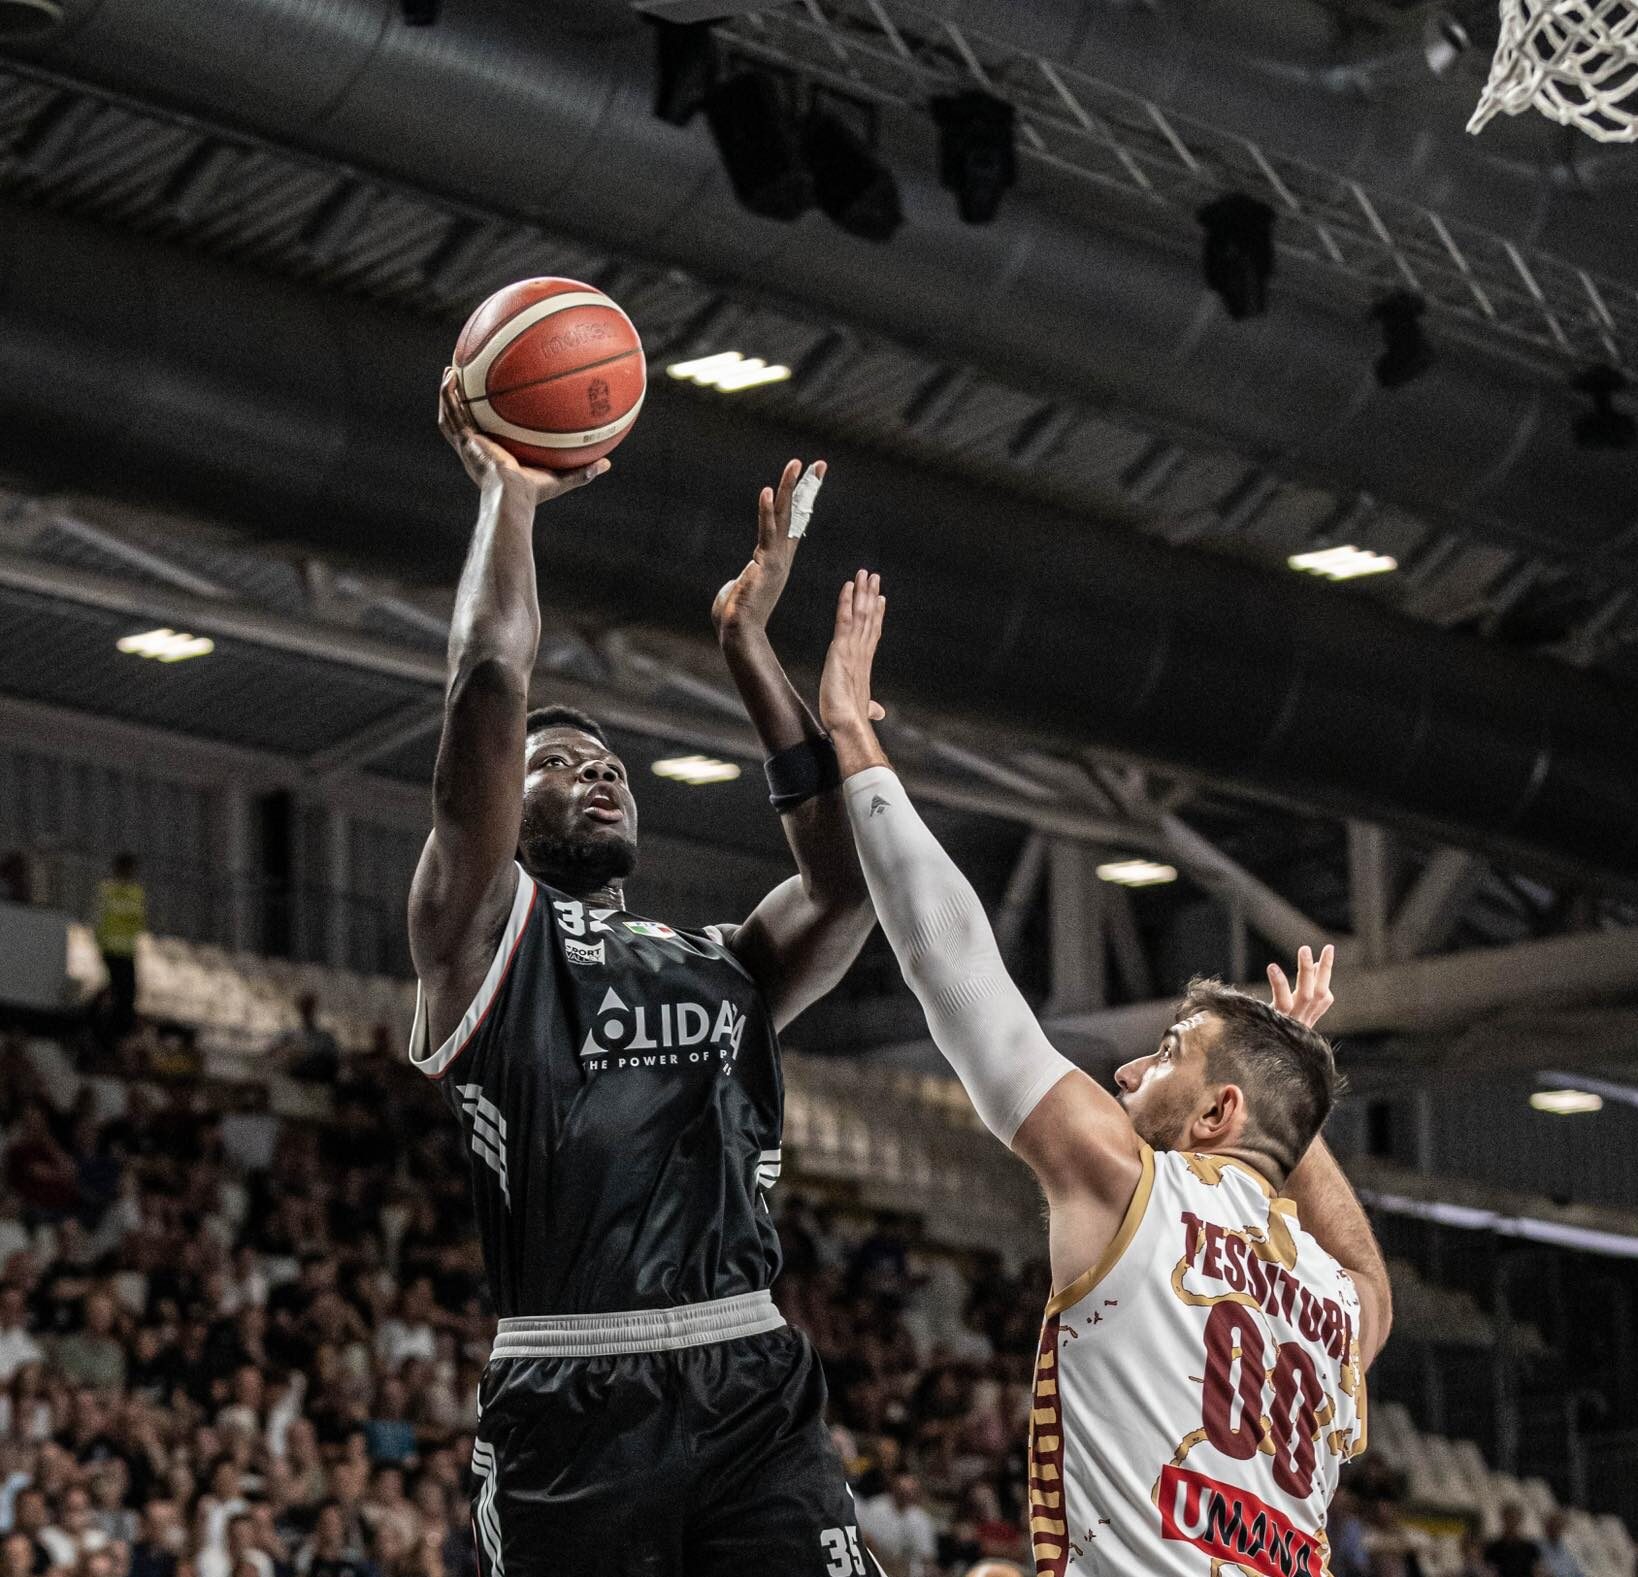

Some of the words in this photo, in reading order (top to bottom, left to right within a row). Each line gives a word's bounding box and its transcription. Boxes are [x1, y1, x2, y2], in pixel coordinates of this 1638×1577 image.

[618, 1054, 679, 1069] POWER
[689, 1052, 710, 1063] OF
[1202, 1300, 1324, 1499] 00
[820, 1525, 866, 1577] 35
[1173, 1480, 1314, 1577] UMANA
